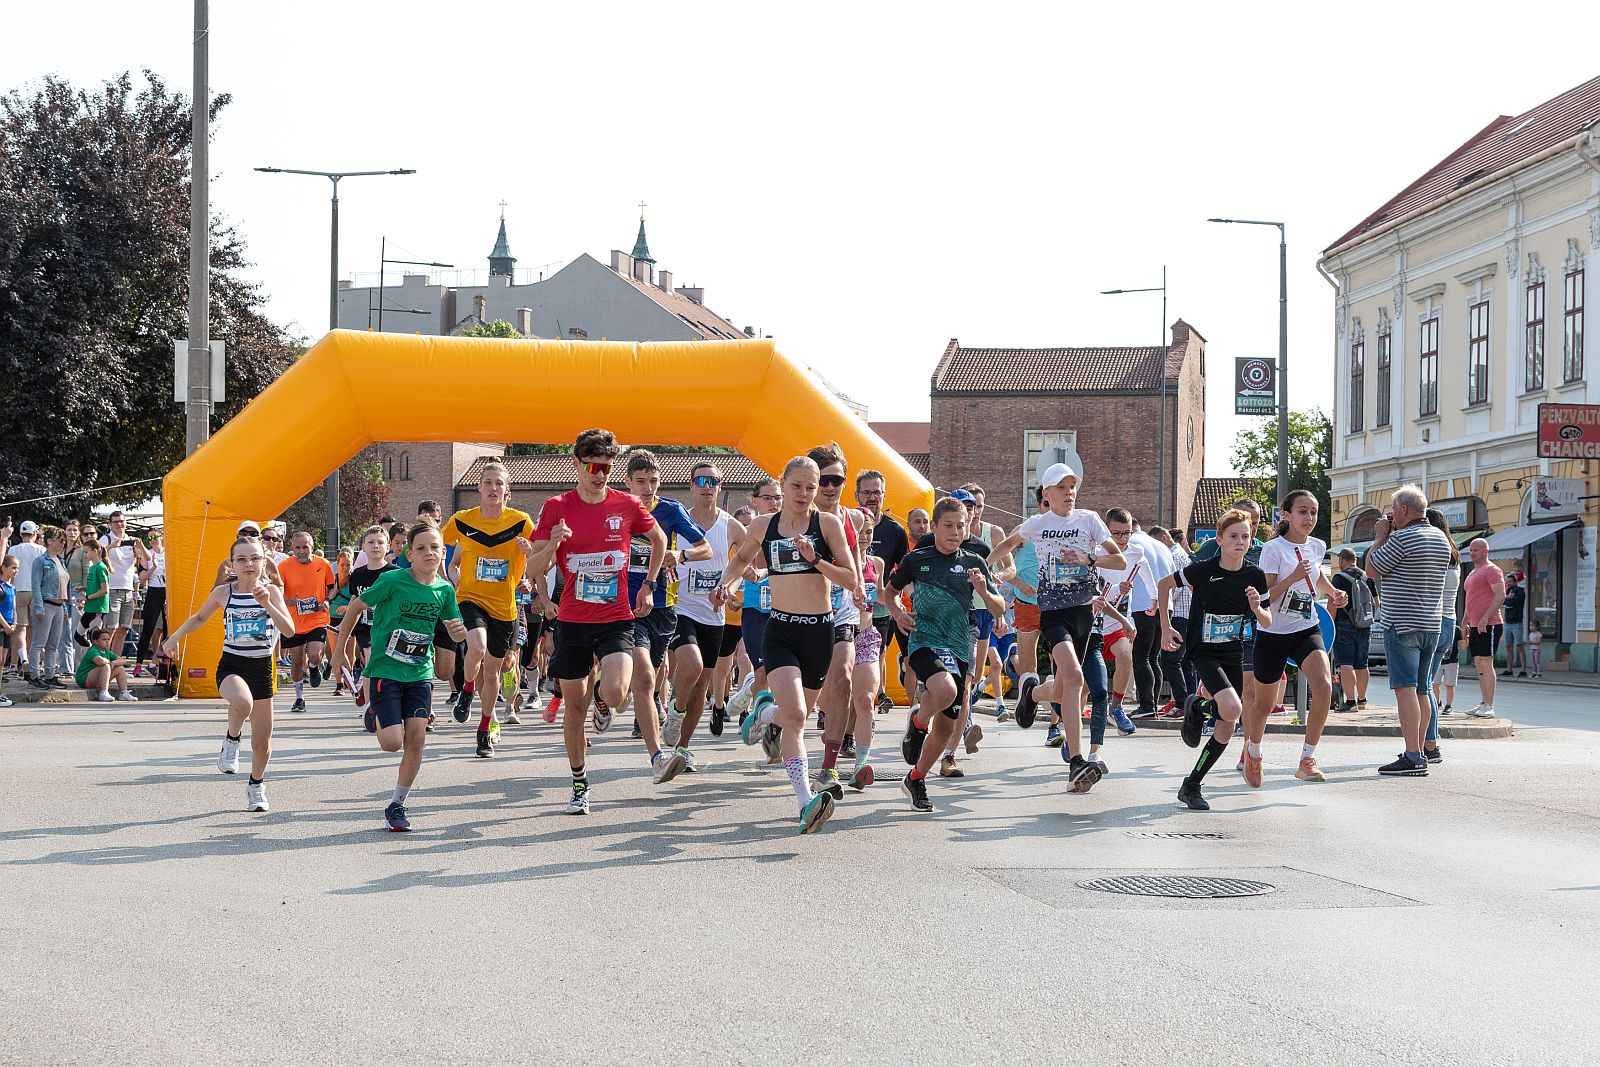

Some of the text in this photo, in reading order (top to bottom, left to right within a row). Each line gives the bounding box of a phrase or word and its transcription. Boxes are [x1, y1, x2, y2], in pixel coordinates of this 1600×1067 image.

[1041, 528, 1079, 539] ROUGH
[640, 556, 648, 565] 7
[792, 551, 801, 561] 8
[578, 559, 603, 568] kendel
[1058, 566, 1081, 575] 3227
[697, 579, 717, 588] 7053
[587, 585, 611, 595] 3137
[413, 602, 440, 617] TESZ
[789, 615, 818, 625] PRO
[236, 622, 260, 633] 3134
[1214, 625, 1234, 635] 3130
[405, 644, 417, 654] 17
